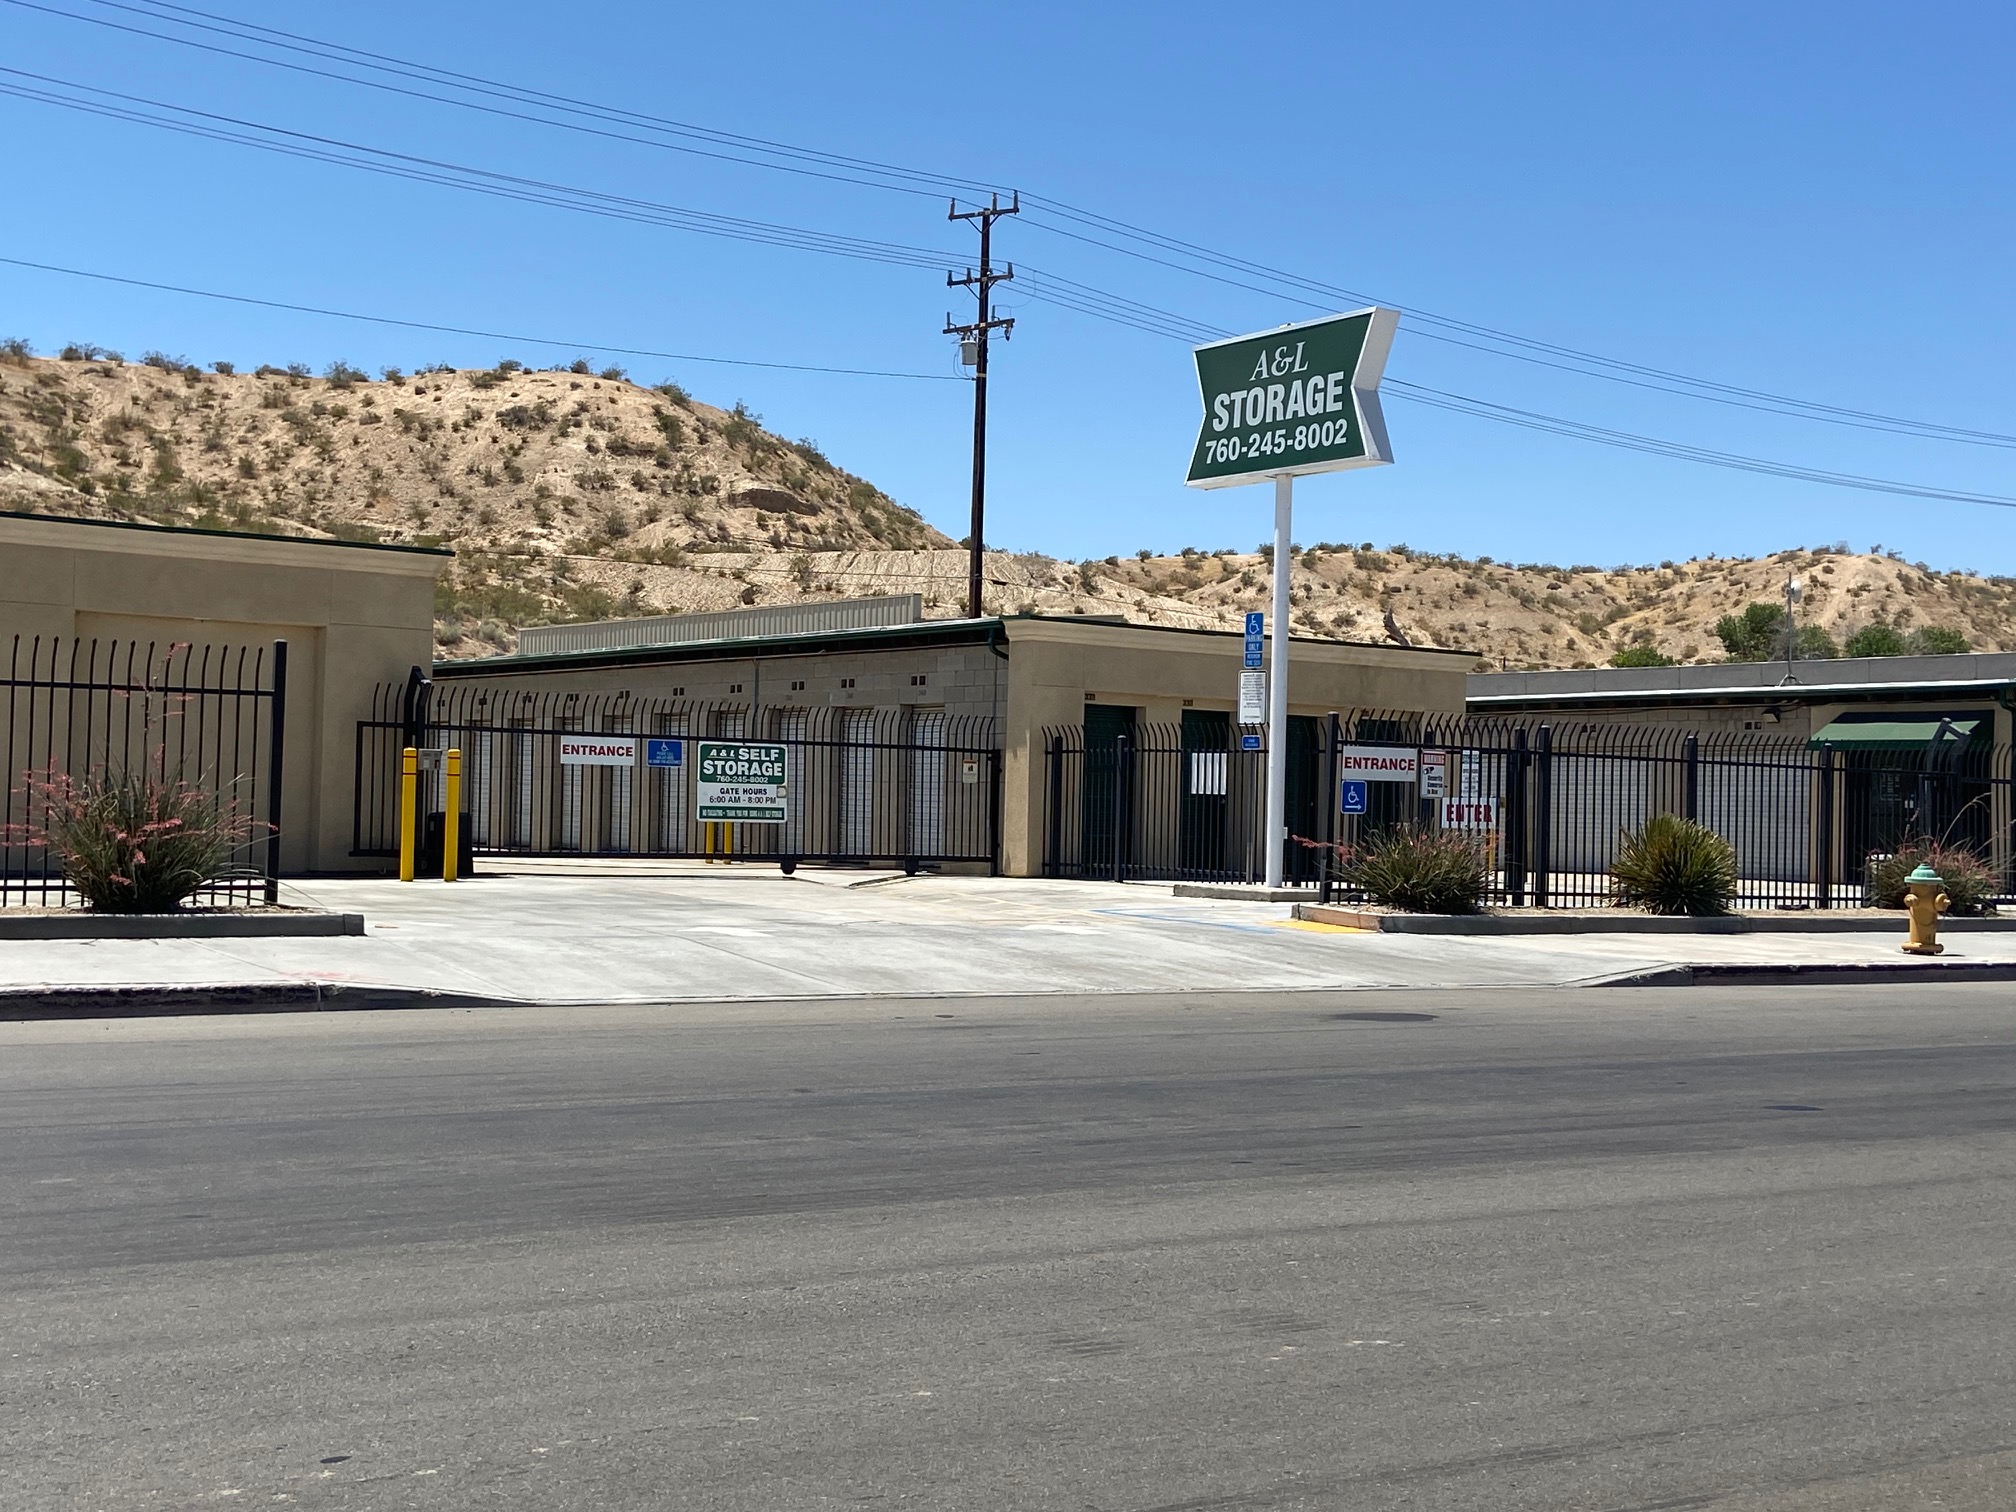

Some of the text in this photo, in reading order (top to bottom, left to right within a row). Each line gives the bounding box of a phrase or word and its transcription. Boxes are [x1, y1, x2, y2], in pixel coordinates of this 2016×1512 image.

[1249, 341, 1309, 381] A&L
[1212, 371, 1345, 432] STORAGE
[1205, 418, 1348, 464] 760-245-8002
[562, 744, 633, 757] ENTRANCE
[719, 749, 727, 757] &
[730, 749, 735, 757] L
[738, 747, 780, 761] SELF
[702, 759, 783, 777] STORAGE
[1344, 756, 1415, 771] ENTRANCE
[715, 775, 769, 784] 760-245-8002
[720, 787, 768, 796] GATE HOURS
[709, 795, 726, 804] 6:00
[728, 796, 741, 804] AM
[747, 796, 764, 804] 8:00
[765, 796, 777, 804] PM
[1446, 804, 1493, 823] ENTER
